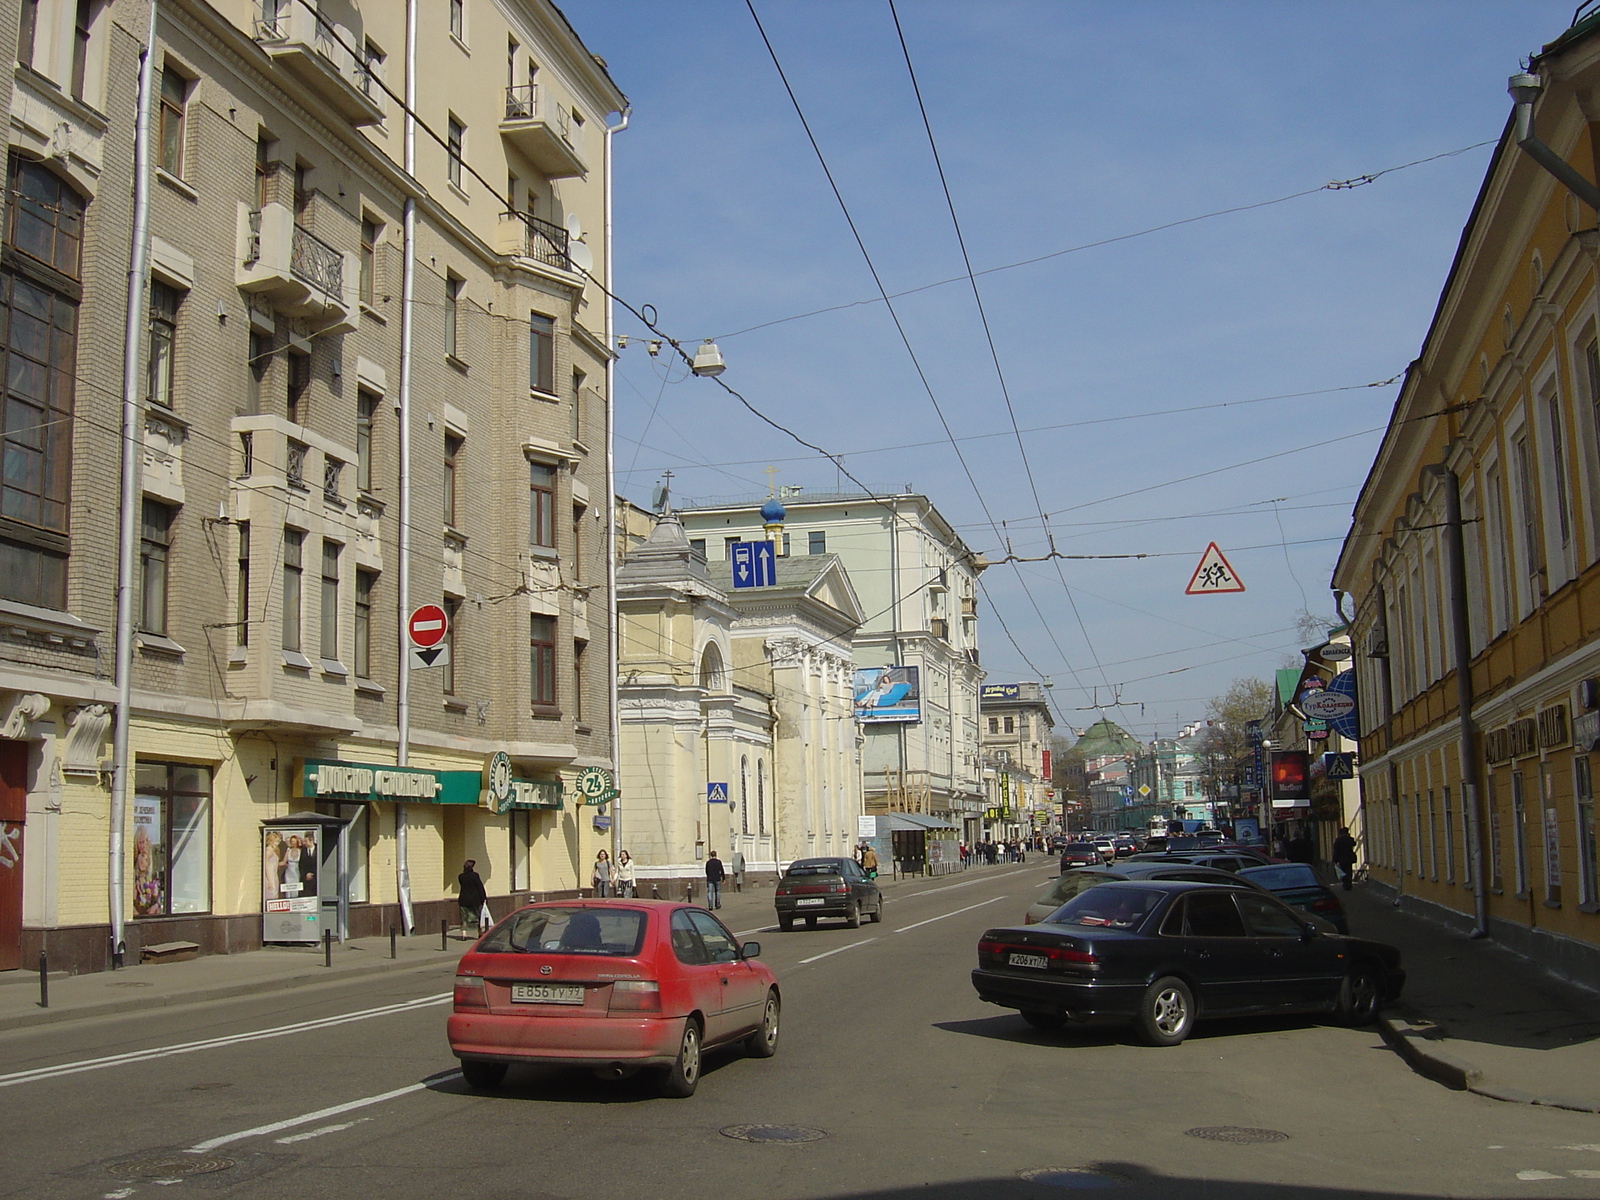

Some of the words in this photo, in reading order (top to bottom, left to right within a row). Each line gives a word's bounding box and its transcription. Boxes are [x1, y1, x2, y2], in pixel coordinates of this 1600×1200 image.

[316, 765, 373, 794] ДОКТОР
[375, 770, 436, 797] СТОЛЕТОВ
[586, 774, 602, 794] 24
[268, 900, 291, 911] HELLO!
